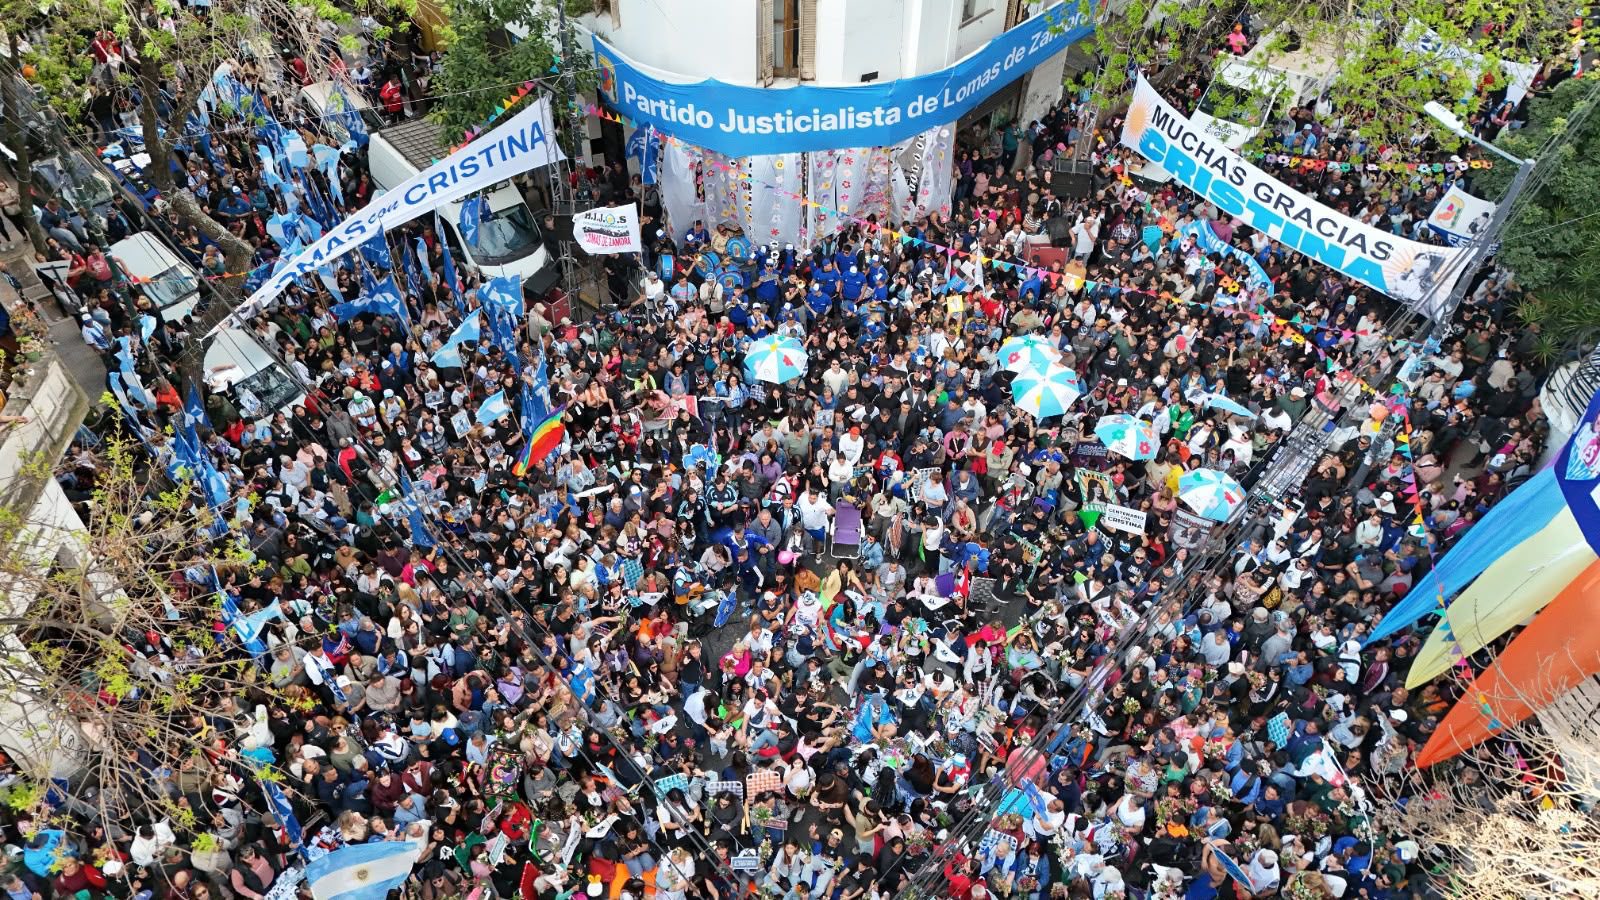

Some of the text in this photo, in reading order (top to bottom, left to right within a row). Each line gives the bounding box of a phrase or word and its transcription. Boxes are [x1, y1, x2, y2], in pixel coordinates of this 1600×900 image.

[623, 81, 714, 129] Partido
[719, 104, 901, 135] Justicialista
[908, 91, 939, 119] de
[942, 60, 1001, 109] Lomas
[1004, 45, 1027, 71] de
[367, 200, 399, 224] con
[404, 120, 548, 205] CRISTINA
[1138, 127, 1390, 294] CRISTINA
[1151, 104, 1248, 186] MUCHAS
[1253, 181, 1393, 262] GRACIAS
[1107, 516, 1143, 530] CRISTINA
